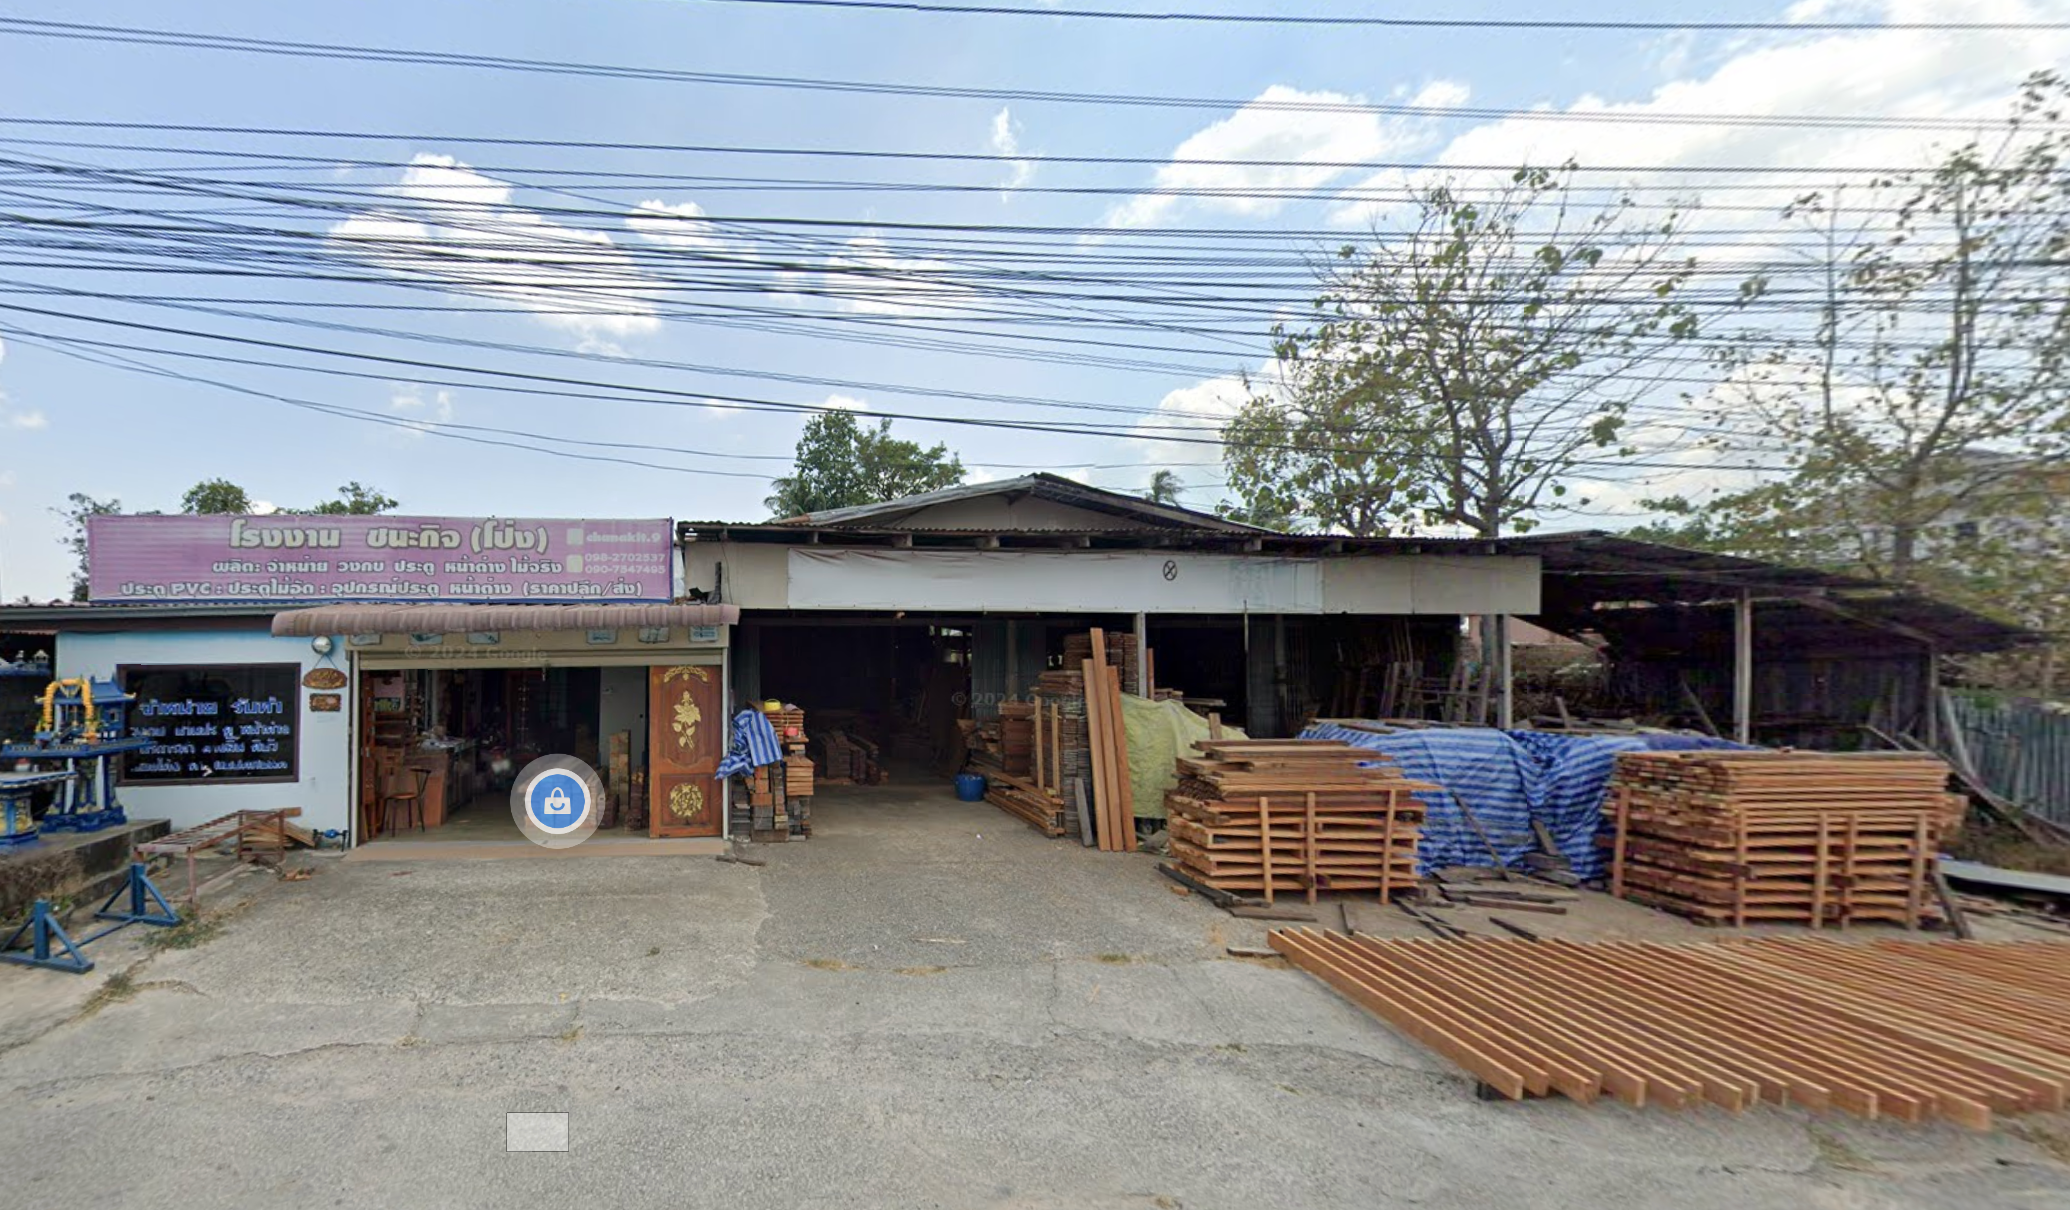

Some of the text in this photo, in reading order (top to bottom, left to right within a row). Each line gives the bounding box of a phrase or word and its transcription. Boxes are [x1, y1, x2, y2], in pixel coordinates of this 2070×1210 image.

[230, 518, 549, 555] โรงงาน ชนะกิจ (โป่ง)
[267, 554, 328, 573] จำหน่าย
[337, 560, 384, 573] วงกบ
[394, 559, 435, 576] ประตู
[444, 554, 506, 573] หน้าต่าง
[510, 555, 563, 574] ไม้จริง
[121, 581, 167, 598] ประตู
[170, 581, 211, 596] PVC
[228, 577, 314, 597] ประตูไม้อัด
[332, 577, 440, 597] อุปกรณ์ประตู
[450, 577, 513, 595] หน้าต่าง
[523, 576, 643, 597] (ราคาปลีก/ส่ง)
